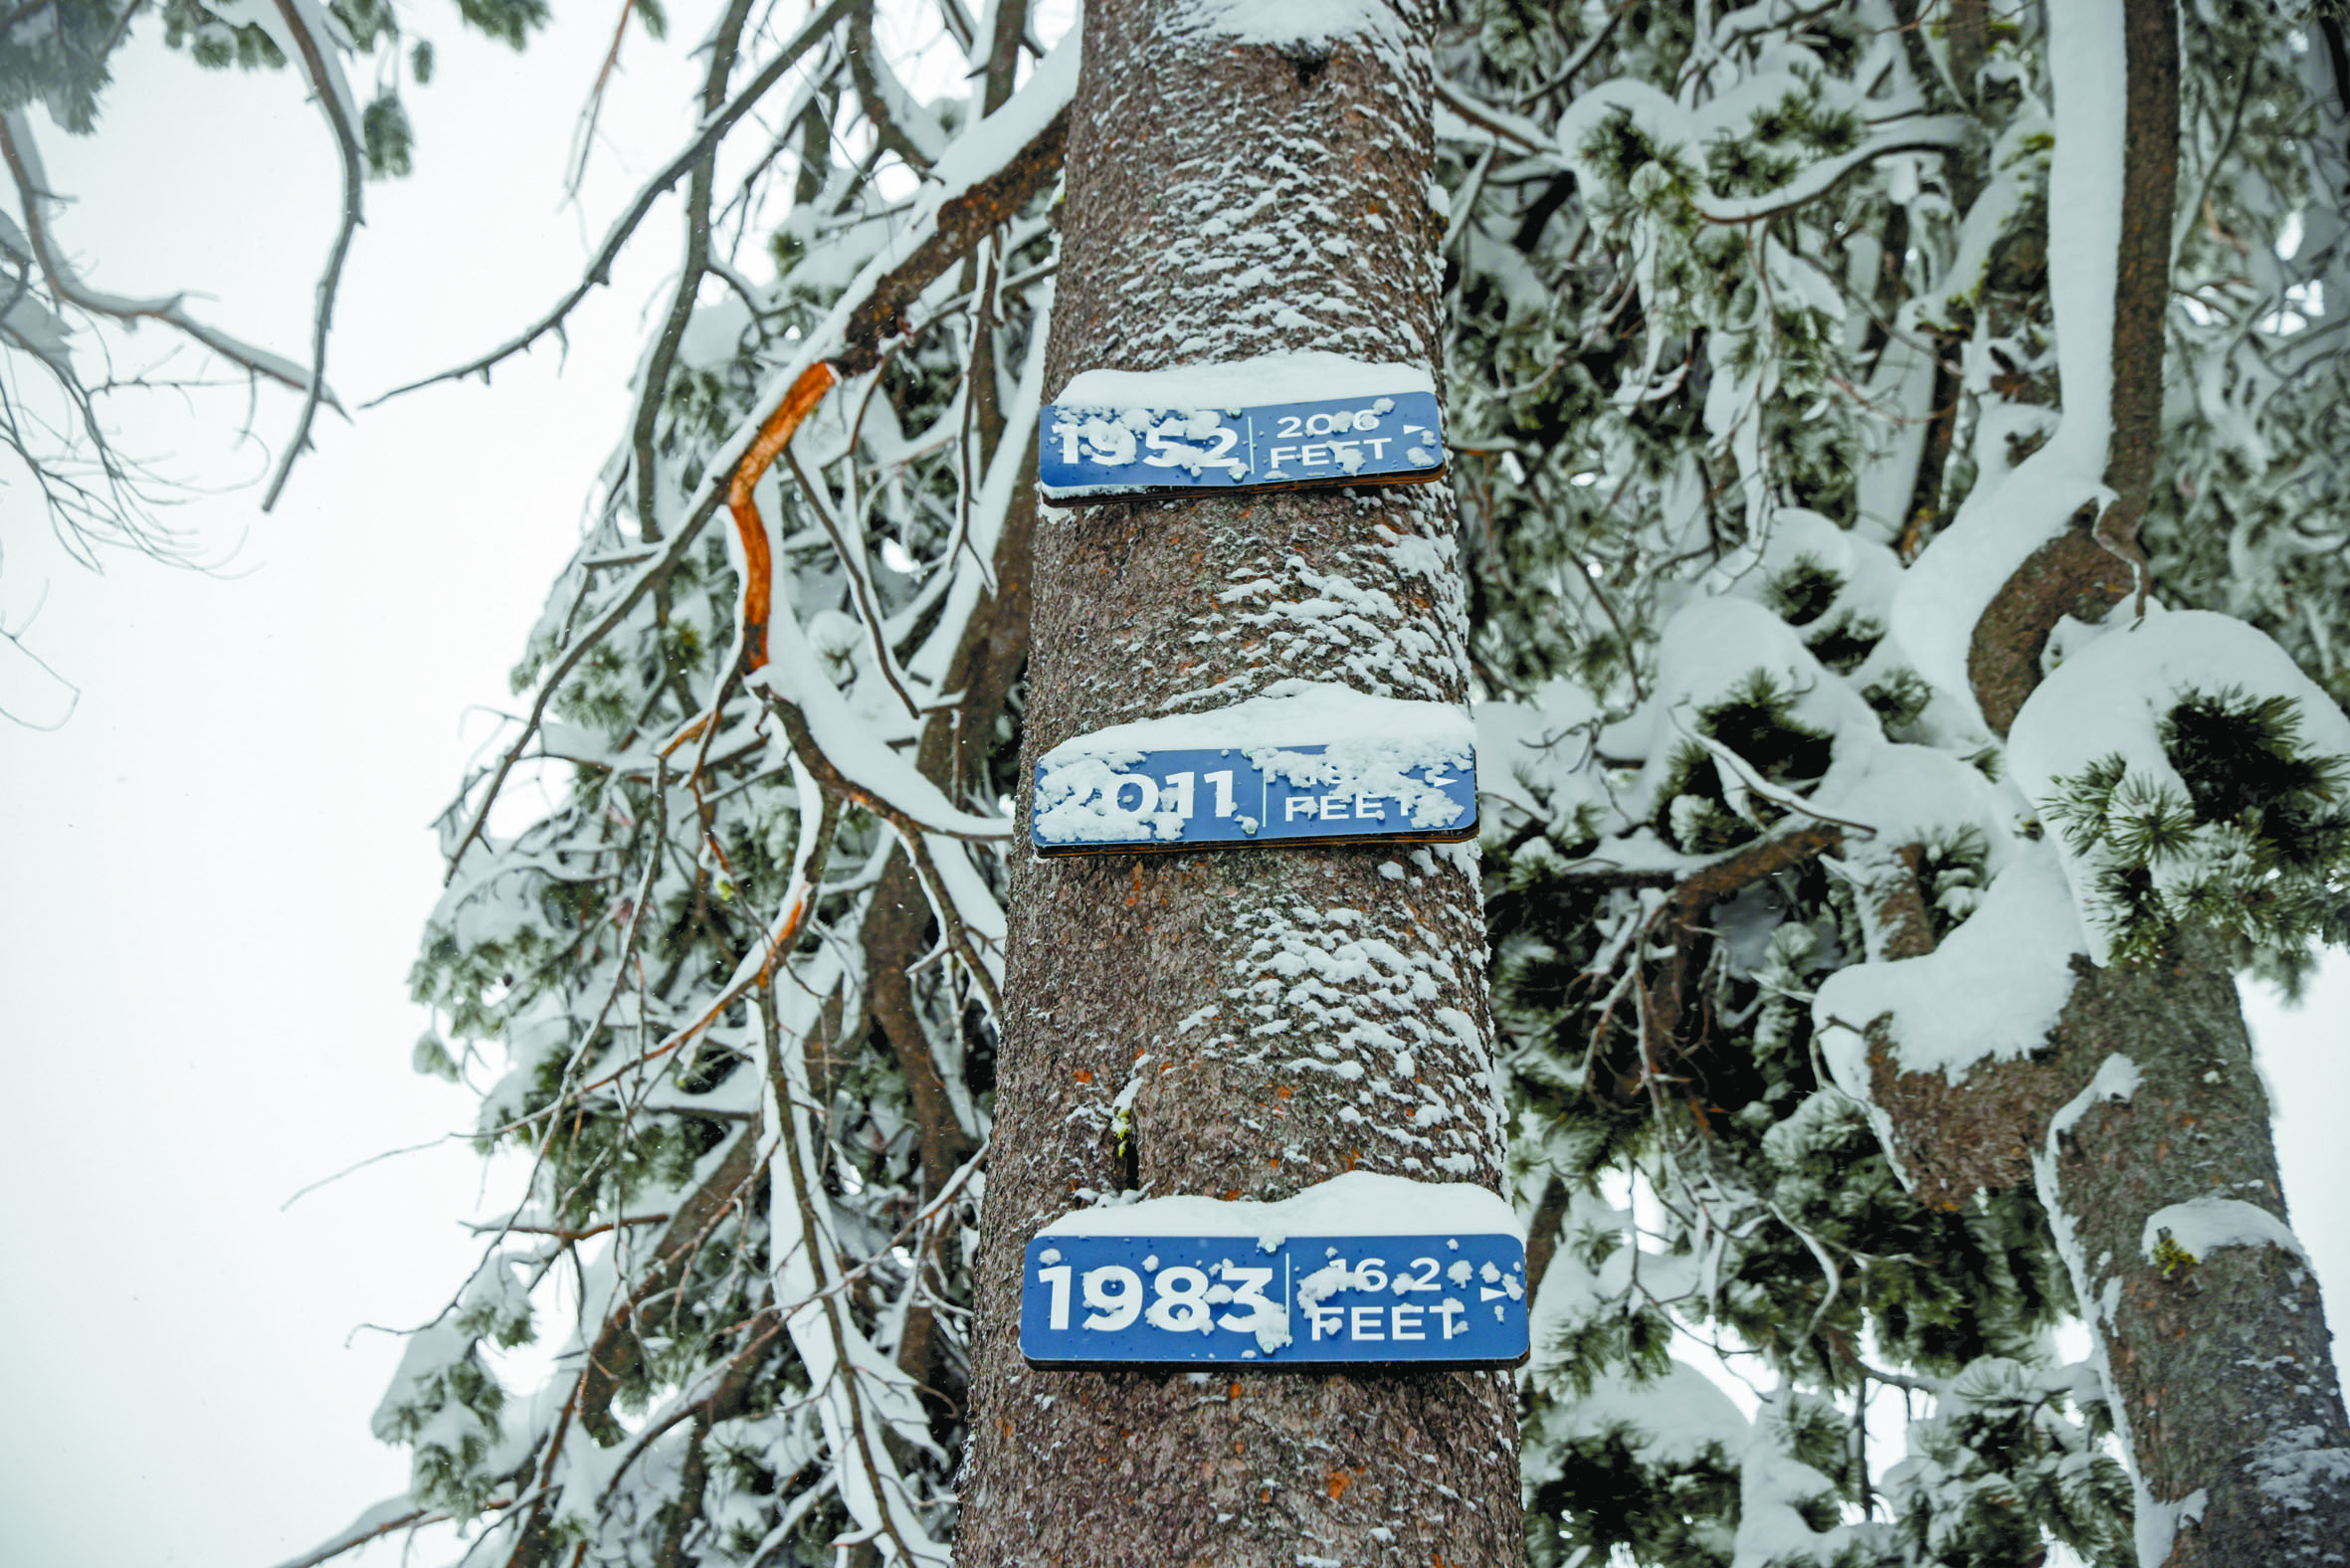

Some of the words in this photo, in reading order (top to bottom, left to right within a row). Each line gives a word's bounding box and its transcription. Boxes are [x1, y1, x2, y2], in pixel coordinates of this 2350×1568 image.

[1276, 409, 1380, 438] 206
[1270, 438, 1392, 469] FET
[1048, 770, 1233, 825] 011
[1328, 1257, 1442, 1292] 162
[1038, 1266, 1280, 1332] 1983
[1311, 1305, 1466, 1341] FEET
